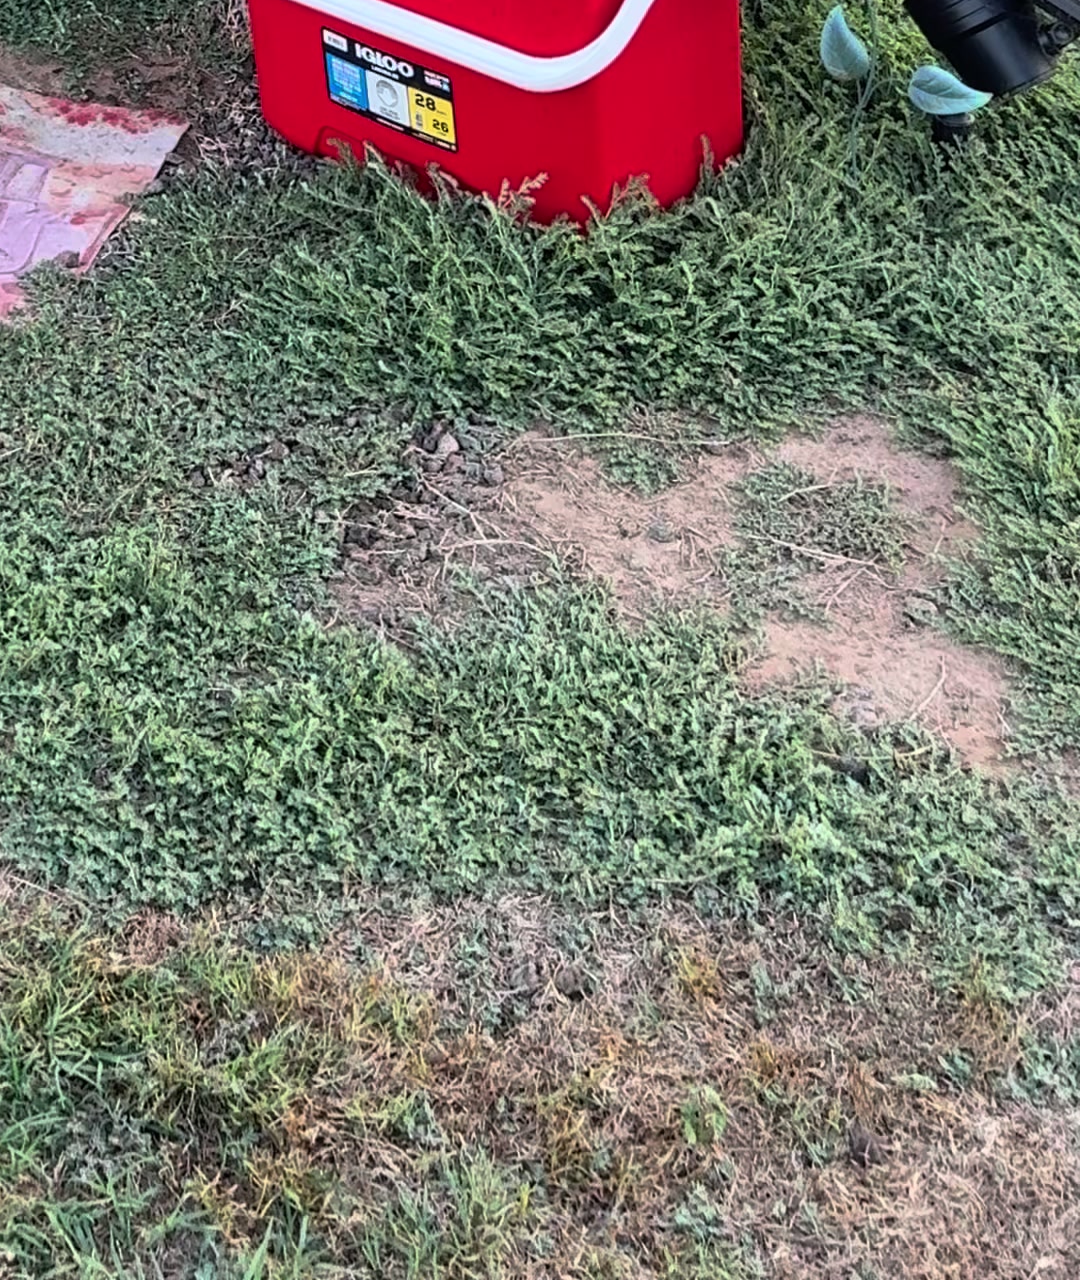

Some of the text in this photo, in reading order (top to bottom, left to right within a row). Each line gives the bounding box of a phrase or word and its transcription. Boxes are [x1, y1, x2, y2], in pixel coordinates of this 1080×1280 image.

[354, 43, 416, 78] IGLOO
[414, 92, 436, 112] 28
[432, 118, 449, 133] 26
